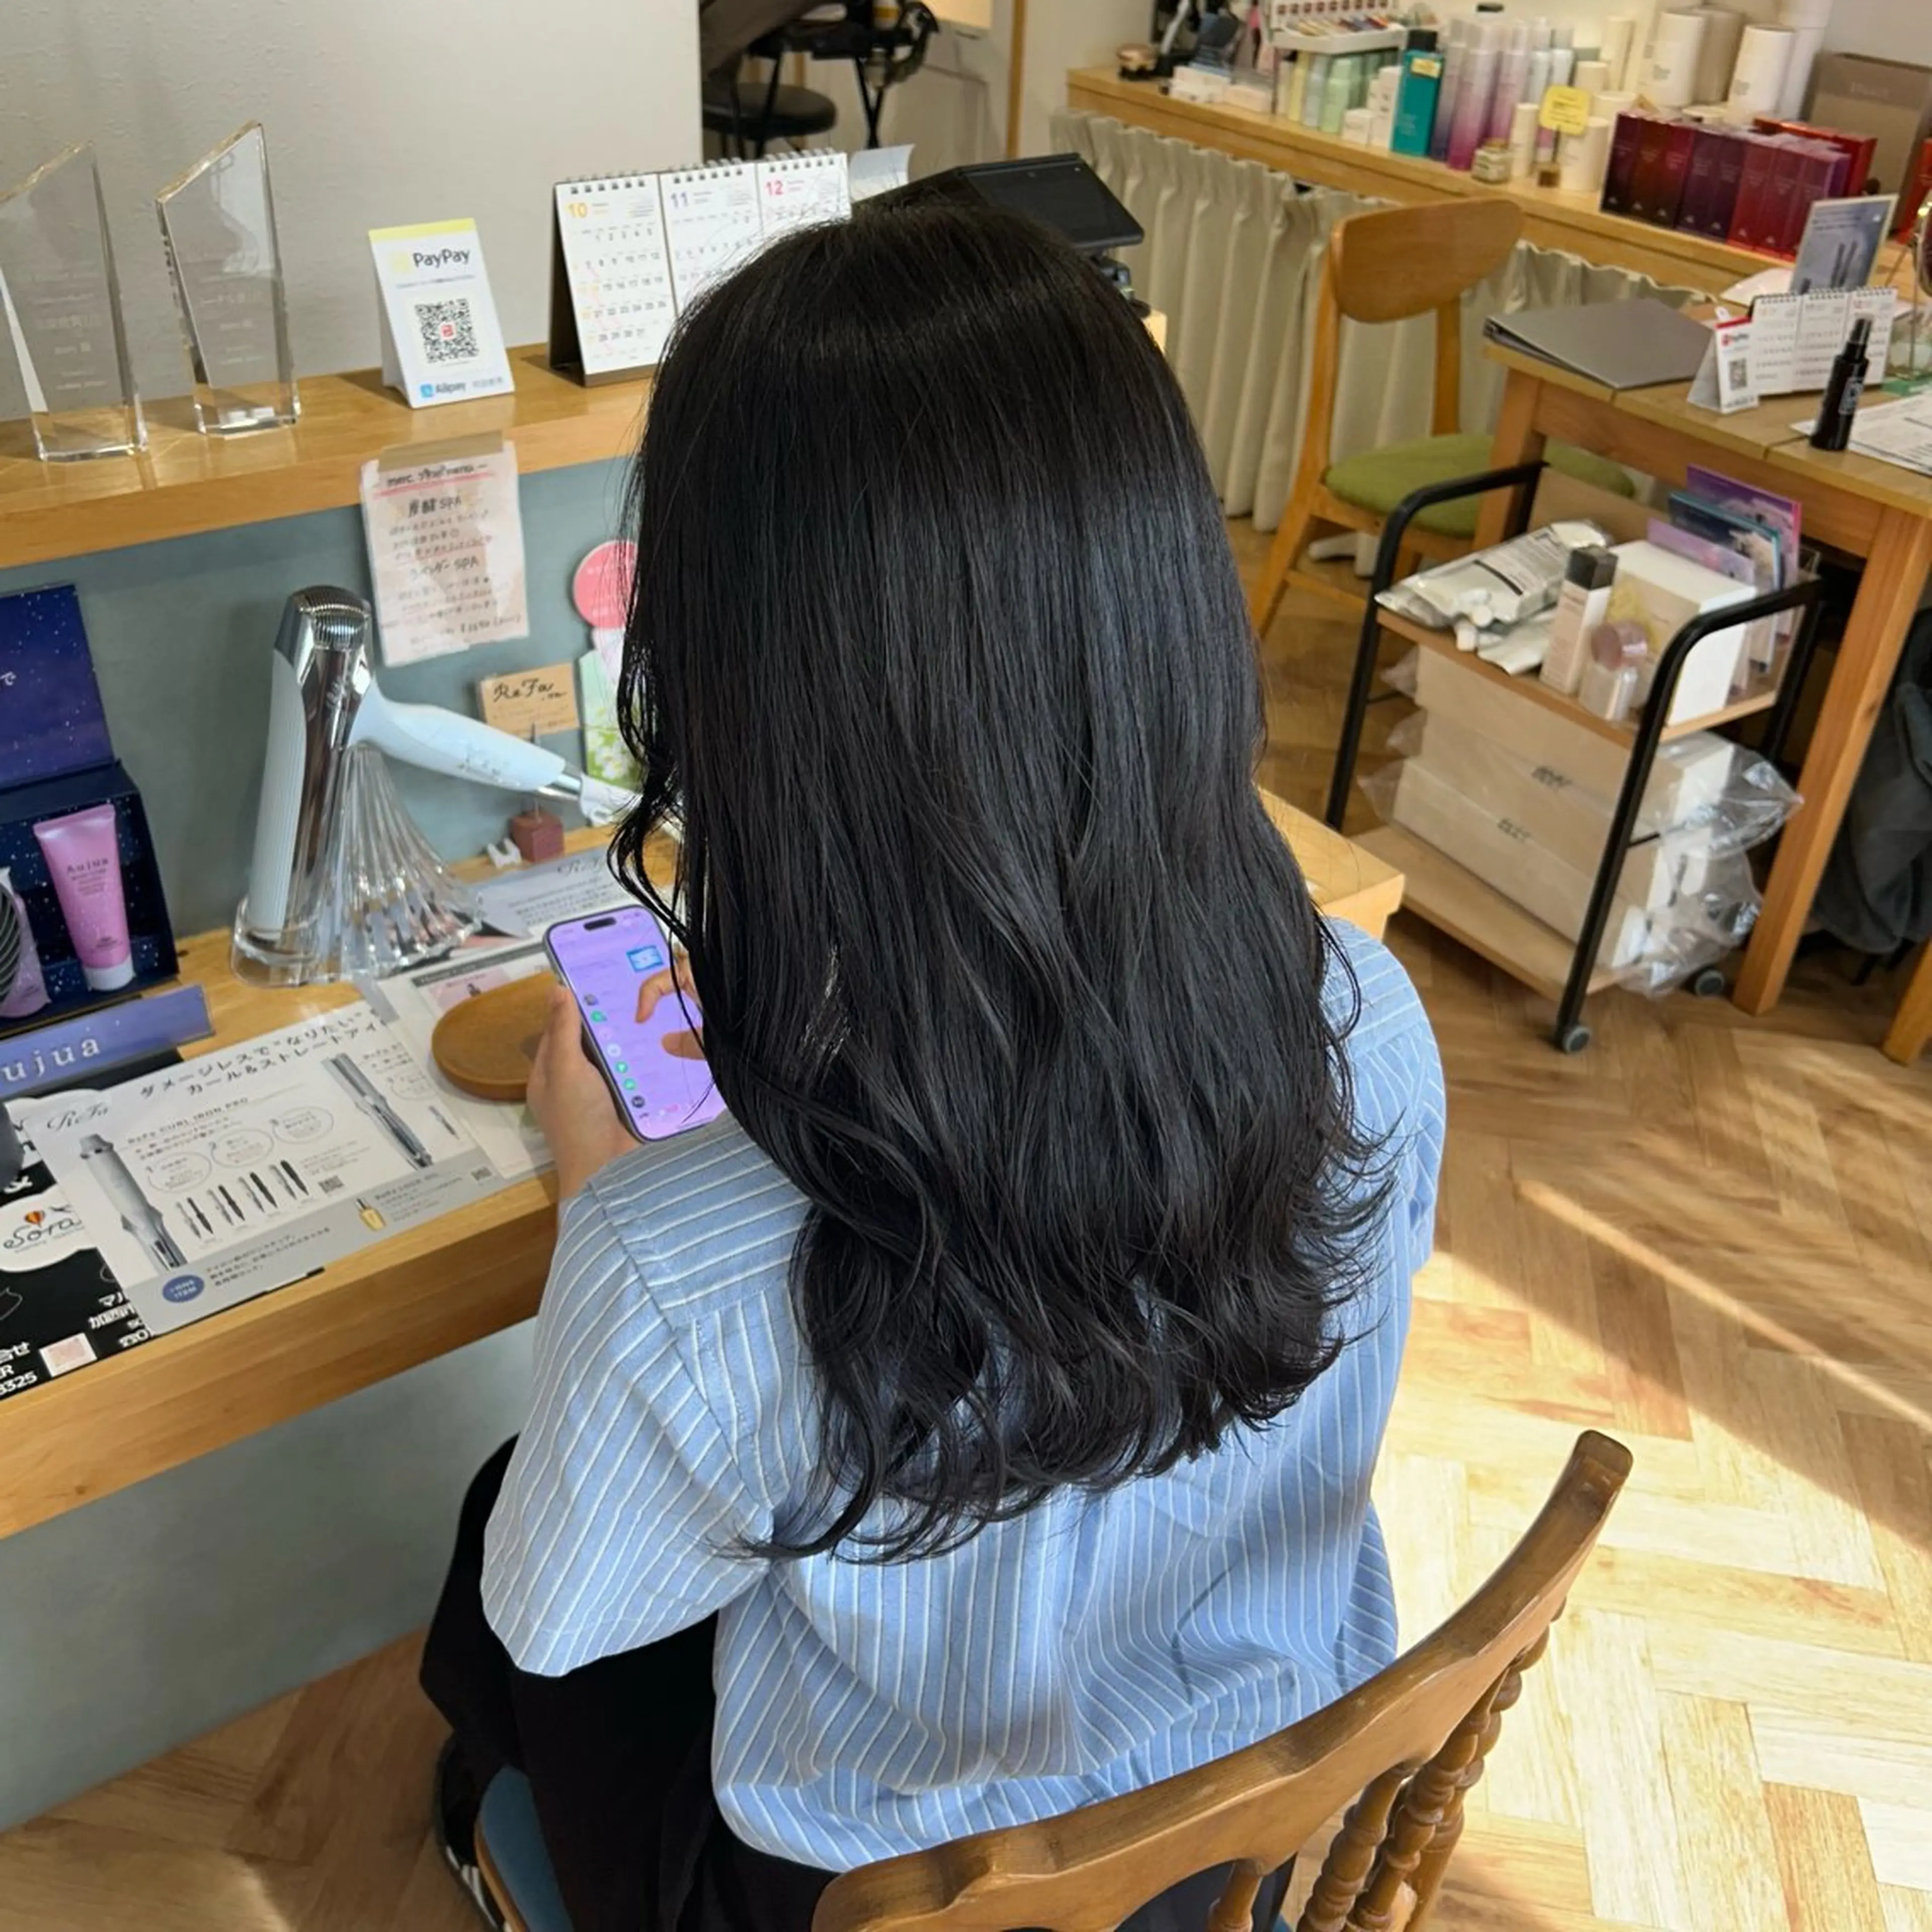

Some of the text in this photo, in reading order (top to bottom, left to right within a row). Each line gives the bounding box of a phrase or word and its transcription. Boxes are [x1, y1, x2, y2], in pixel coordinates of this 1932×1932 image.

[766, 180, 783, 196] 12
[671, 192, 689, 209] 11
[568, 202, 588, 218] 10
[413, 249, 471, 269] PayPay
